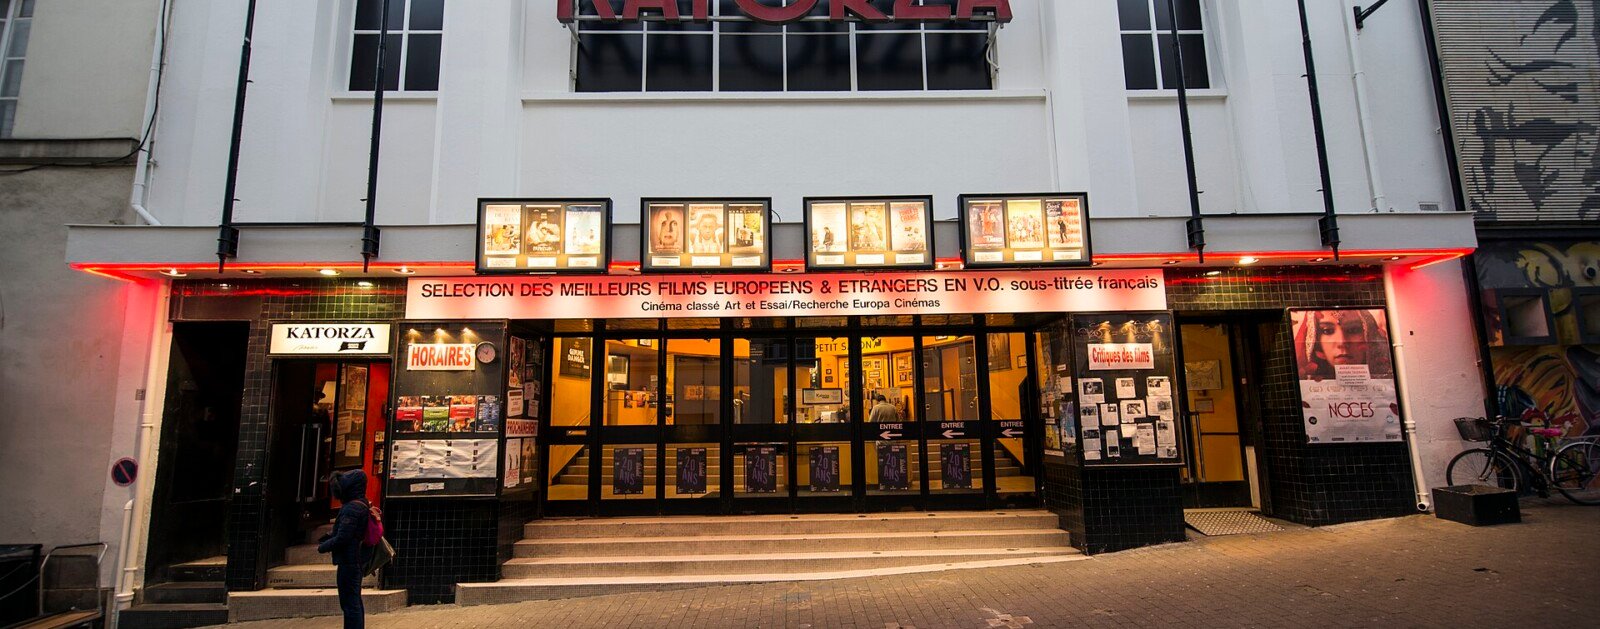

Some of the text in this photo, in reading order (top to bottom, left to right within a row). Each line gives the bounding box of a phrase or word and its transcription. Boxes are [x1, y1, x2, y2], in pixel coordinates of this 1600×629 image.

[421, 275, 1158, 297] SELECTION DES MEILLEURS FILMS EUROPEENS & ETRANGERS EN V.O. sous-titrée français
[641, 297, 940, 311] Cinéma classé Art et Essai/Recherche Europa Cinémas
[286, 327, 375, 339] KATORZA
[411, 346, 471, 367] HORAIRES
[1092, 347, 1150, 367] Critiques des films
[1328, 402, 1374, 418] NOCES
[622, 457, 633, 472] 20
[685, 456, 695, 471] 20
[755, 455, 765, 470] 20
[818, 455, 828, 469] 20
[886, 452, 896, 468] 20
[949, 451, 960, 466] 20
[620, 468, 635, 485] ANS
[682, 467, 698, 485] ANS
[752, 467, 768, 484] ANS
[815, 466, 831, 483] ANS
[884, 464, 899, 481] ANS
[947, 463, 963, 480] ANS
